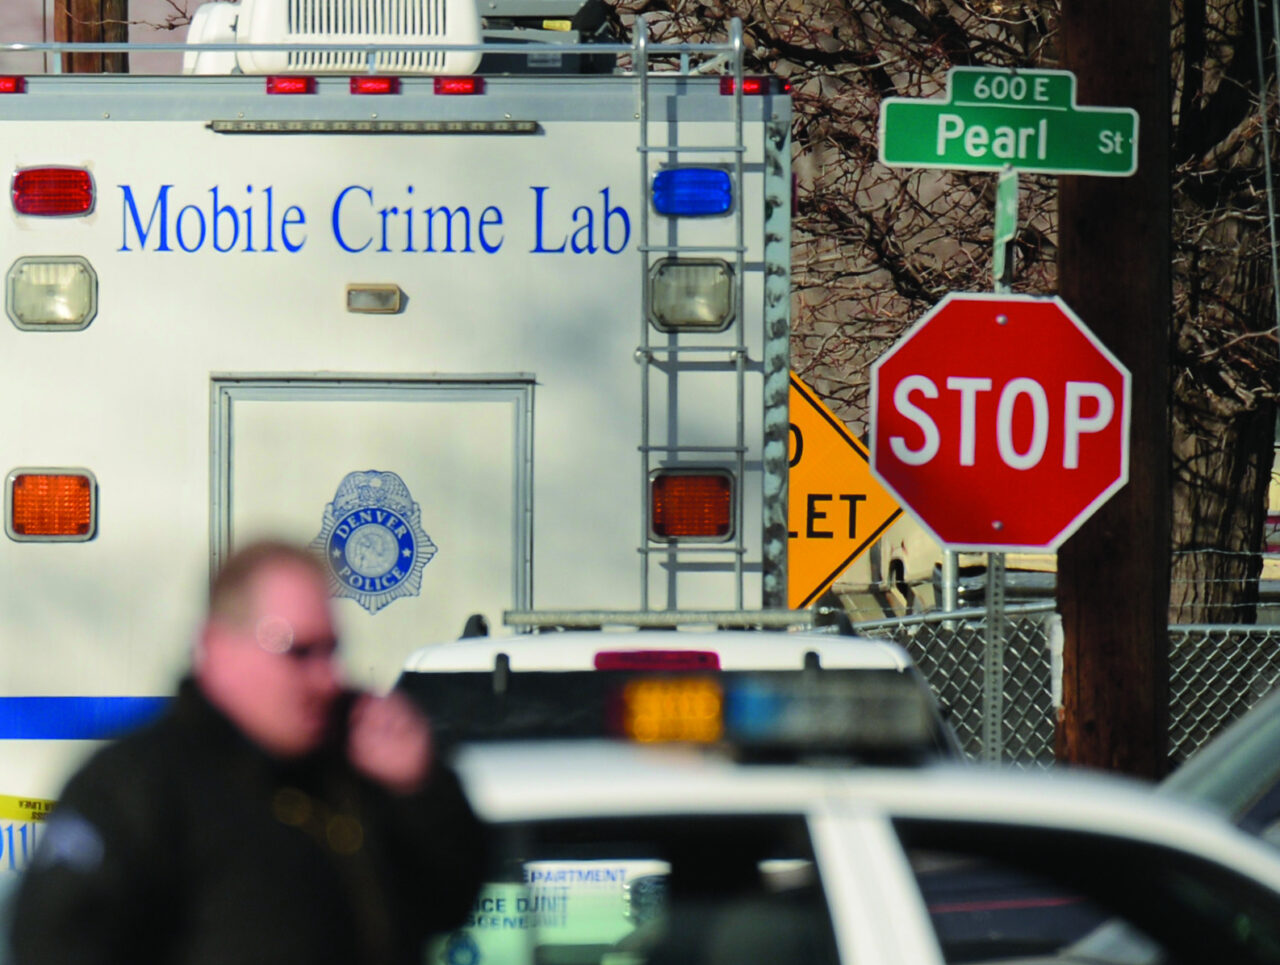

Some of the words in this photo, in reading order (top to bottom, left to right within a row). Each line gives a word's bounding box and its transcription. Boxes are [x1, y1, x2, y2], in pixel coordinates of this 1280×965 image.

[973, 76, 1027, 100] 600
[1033, 78, 1050, 101] E
[936, 113, 1048, 160] Pearl
[1097, 130, 1124, 154] St
[116, 184, 308, 254] Mobile
[331, 185, 505, 254] Crime
[529, 186, 631, 255] Lab
[888, 374, 1115, 471] STOP
[335, 509, 409, 539] DENVER
[338, 565, 406, 591] POLICE
